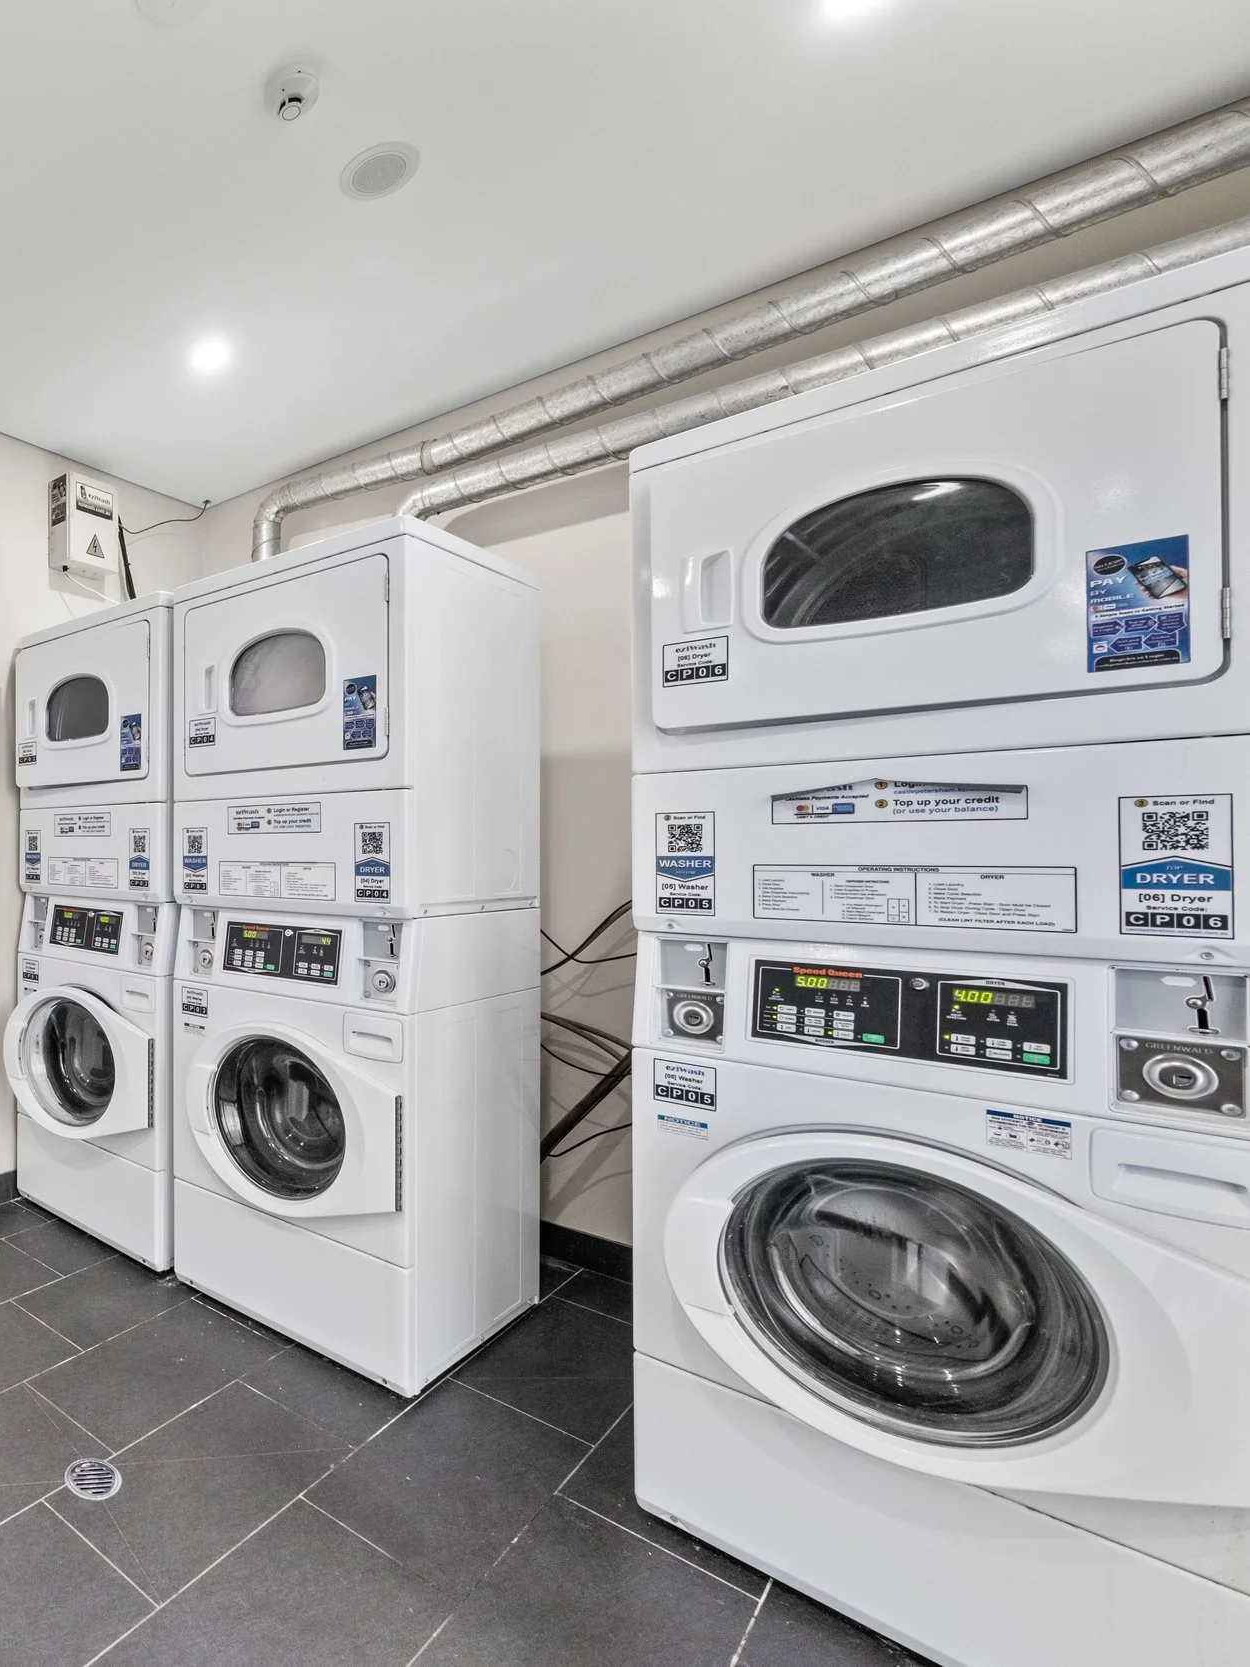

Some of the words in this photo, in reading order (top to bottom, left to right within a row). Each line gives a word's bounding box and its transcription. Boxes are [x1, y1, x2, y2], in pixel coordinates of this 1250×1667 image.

[1090, 576, 1126, 588] PAY
[1090, 593, 1135, 604] MOBILE
[692, 652, 712, 660] Dryer
[667, 665, 723, 681] CP06
[893, 799, 914, 807] Top
[934, 799, 962, 807] your
[965, 796, 1000, 804] credit
[954, 805, 999, 813] balance)
[659, 860, 712, 868] WASHER
[360, 866, 385, 874] DRYER
[1136, 873, 1215, 885] DRYER
[662, 883, 676, 891] [05]
[358, 890, 387, 898] CP04
[1138, 893, 1166, 903] [06]
[1171, 894, 1213, 904] Dryer
[661, 898, 709, 908] CP05
[1129, 914, 1223, 928] CP06
[793, 966, 827, 976] Speed
[828, 969, 863, 979] Queen
[796, 976, 828, 989] 5.00
[954, 989, 993, 1004] 4.00
[183, 1004, 206, 1014] CP03
[1145, 1042, 1213, 1055] GREENWALD
[665, 1073, 677, 1081] [05]
[679, 1076, 703, 1084] Washer
[658, 1086, 712, 1104] CP05
[664, 1116, 702, 1128] NOTICE
[1013, 1114, 1043, 1123] NOTICE
